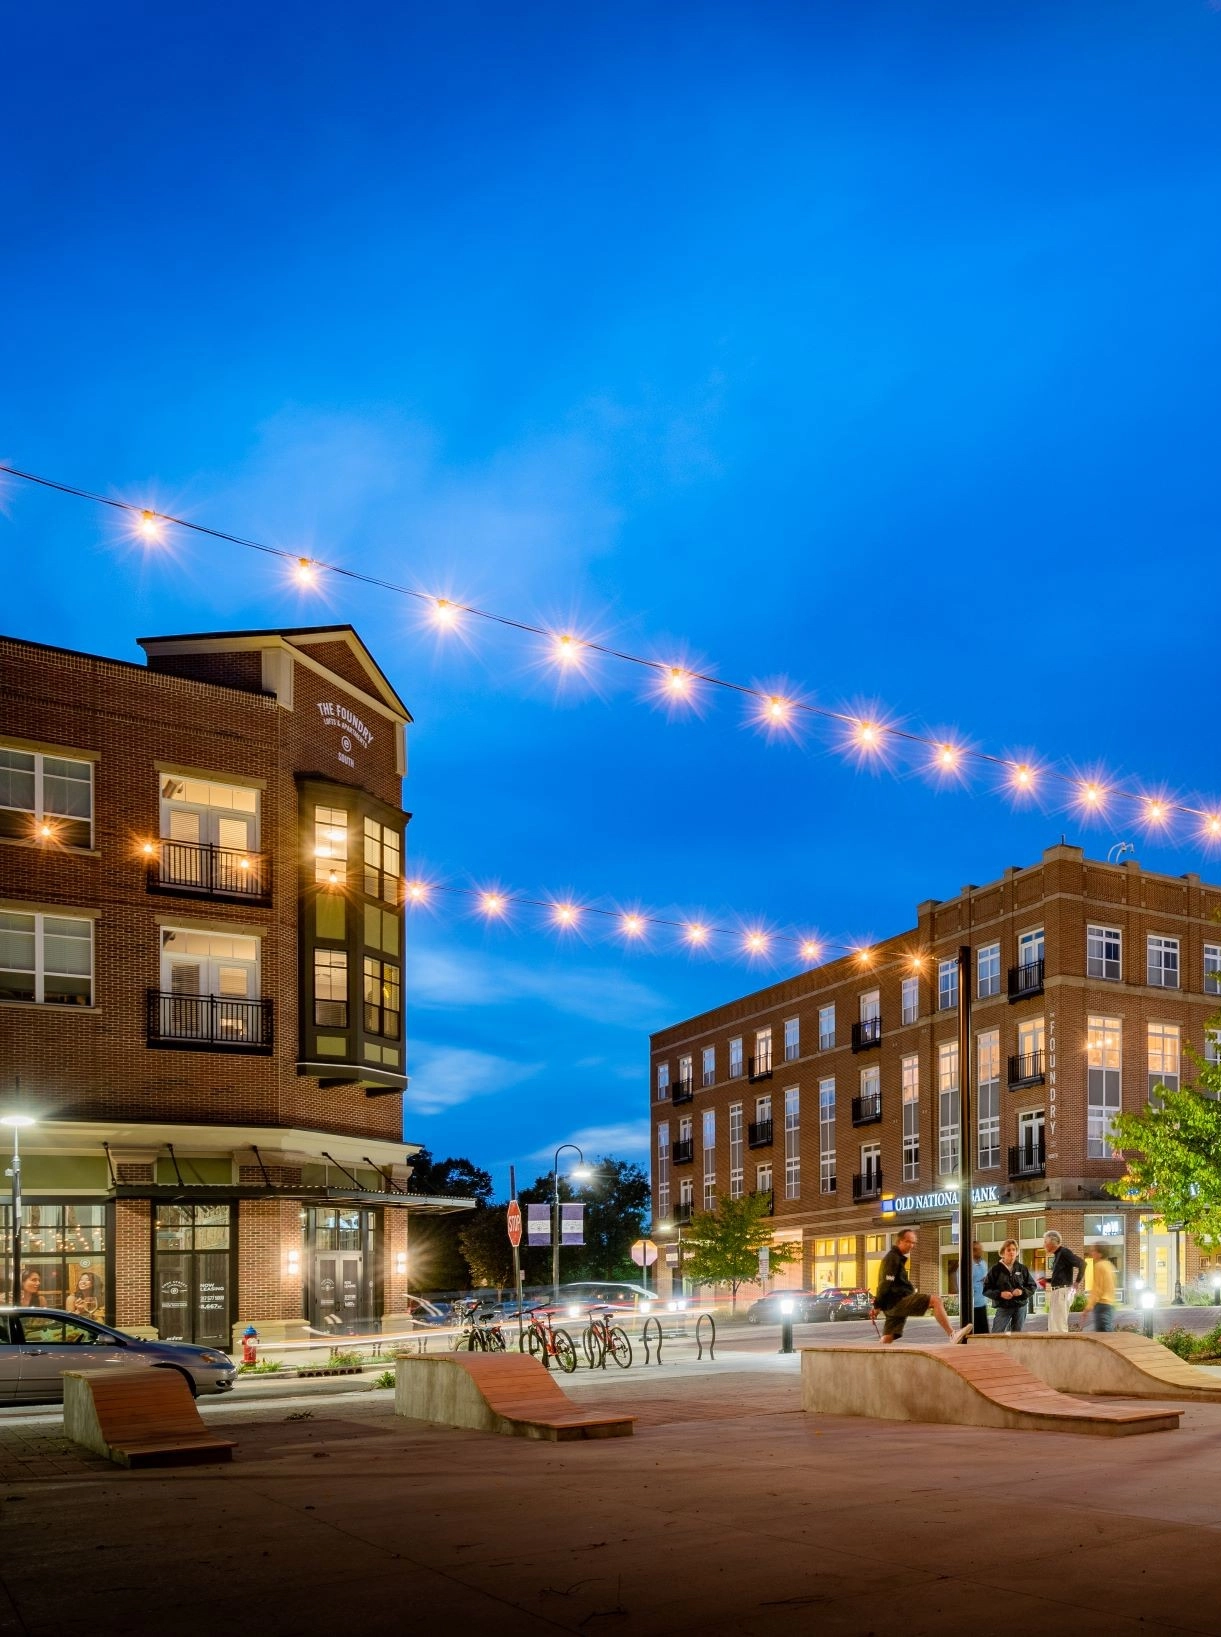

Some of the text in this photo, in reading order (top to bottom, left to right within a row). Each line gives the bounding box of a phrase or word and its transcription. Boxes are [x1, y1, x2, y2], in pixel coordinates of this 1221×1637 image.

[317, 702, 374, 744] THE FOUNDRY
[324, 717, 336, 726] LOFTS
[341, 722, 368, 749] APARTMENTS
[338, 752, 355, 769] SOUTH
[895, 1197, 914, 1212] OLD
[915, 1190, 960, 1209] NATIONA
[509, 1215, 521, 1233] STOP
